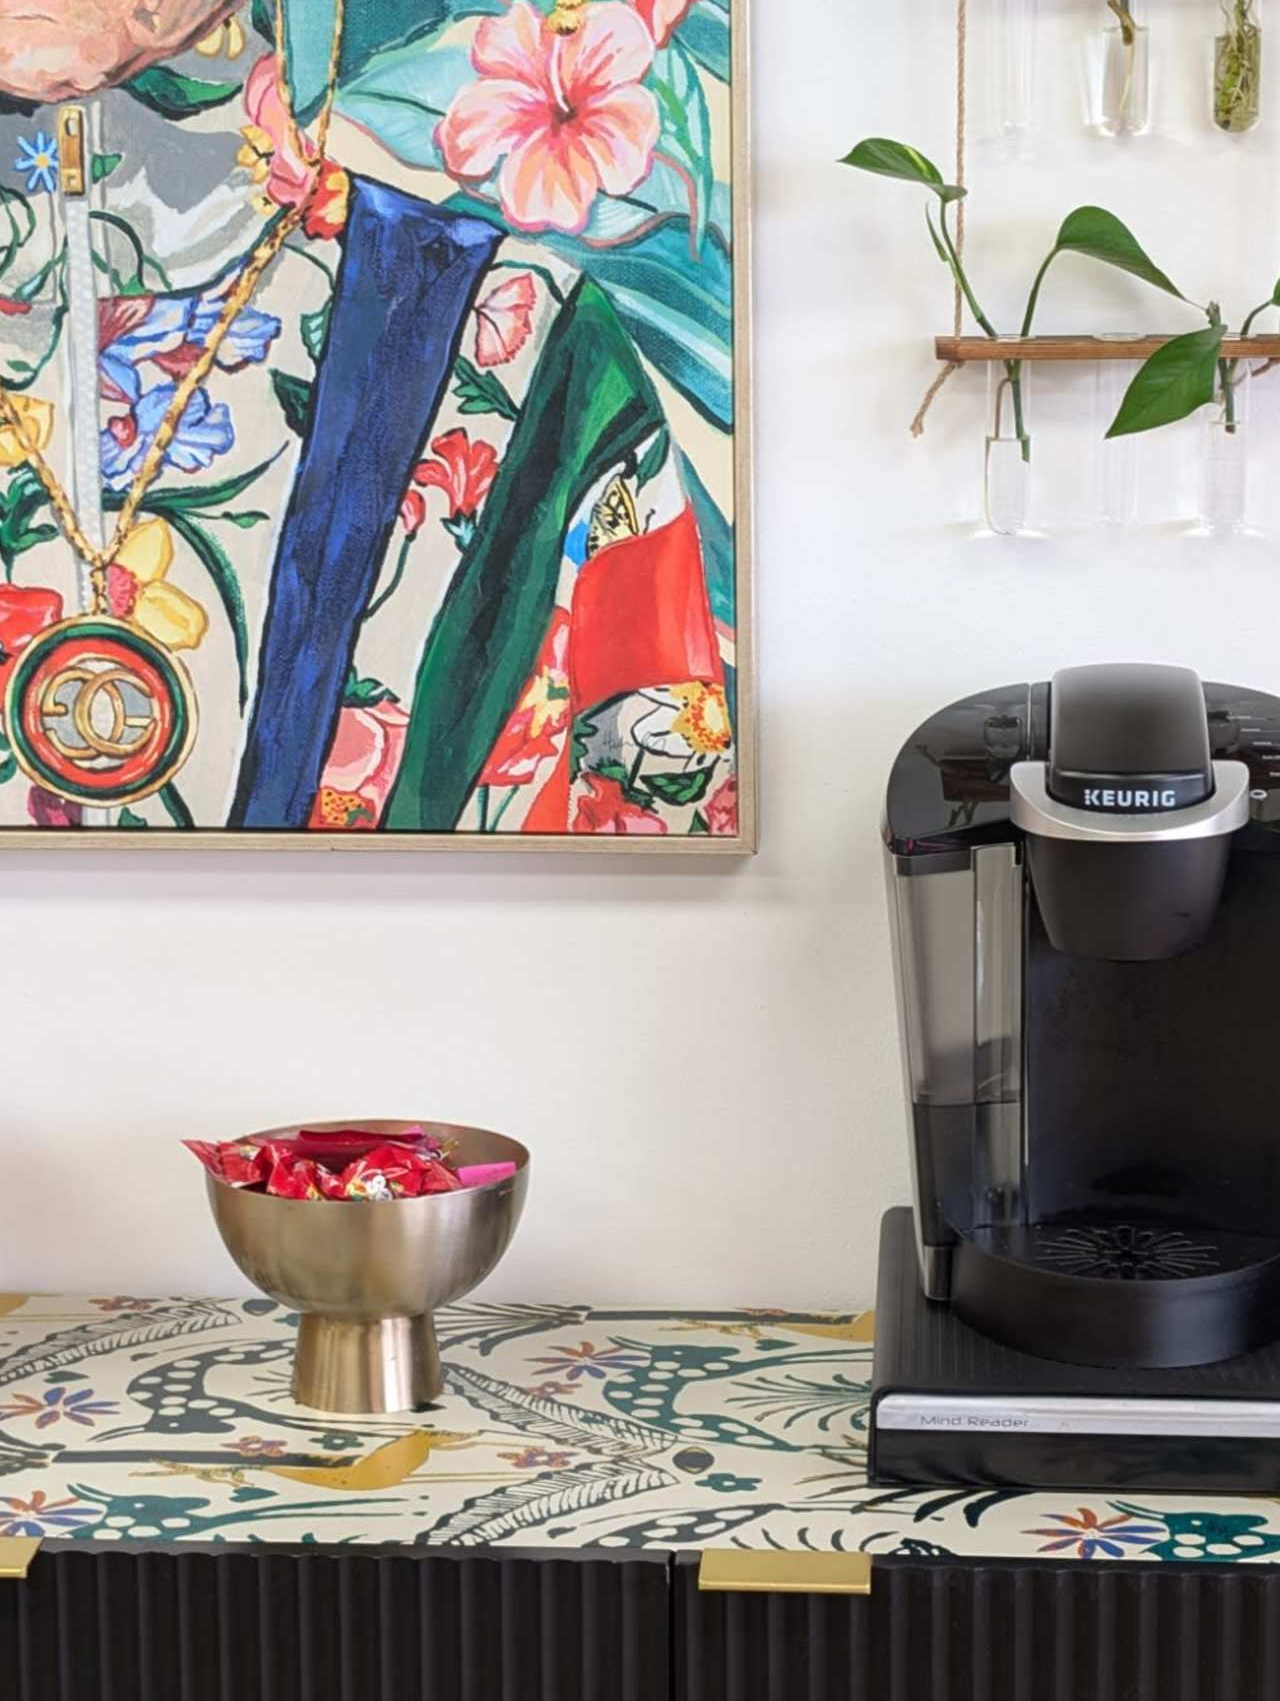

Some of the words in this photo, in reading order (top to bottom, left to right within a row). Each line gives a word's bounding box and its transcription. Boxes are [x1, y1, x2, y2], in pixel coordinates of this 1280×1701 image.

[1083, 788, 1176, 807] KEURIG
[920, 1415, 962, 1426] Mind
[967, 1416, 1029, 1428] Reader
